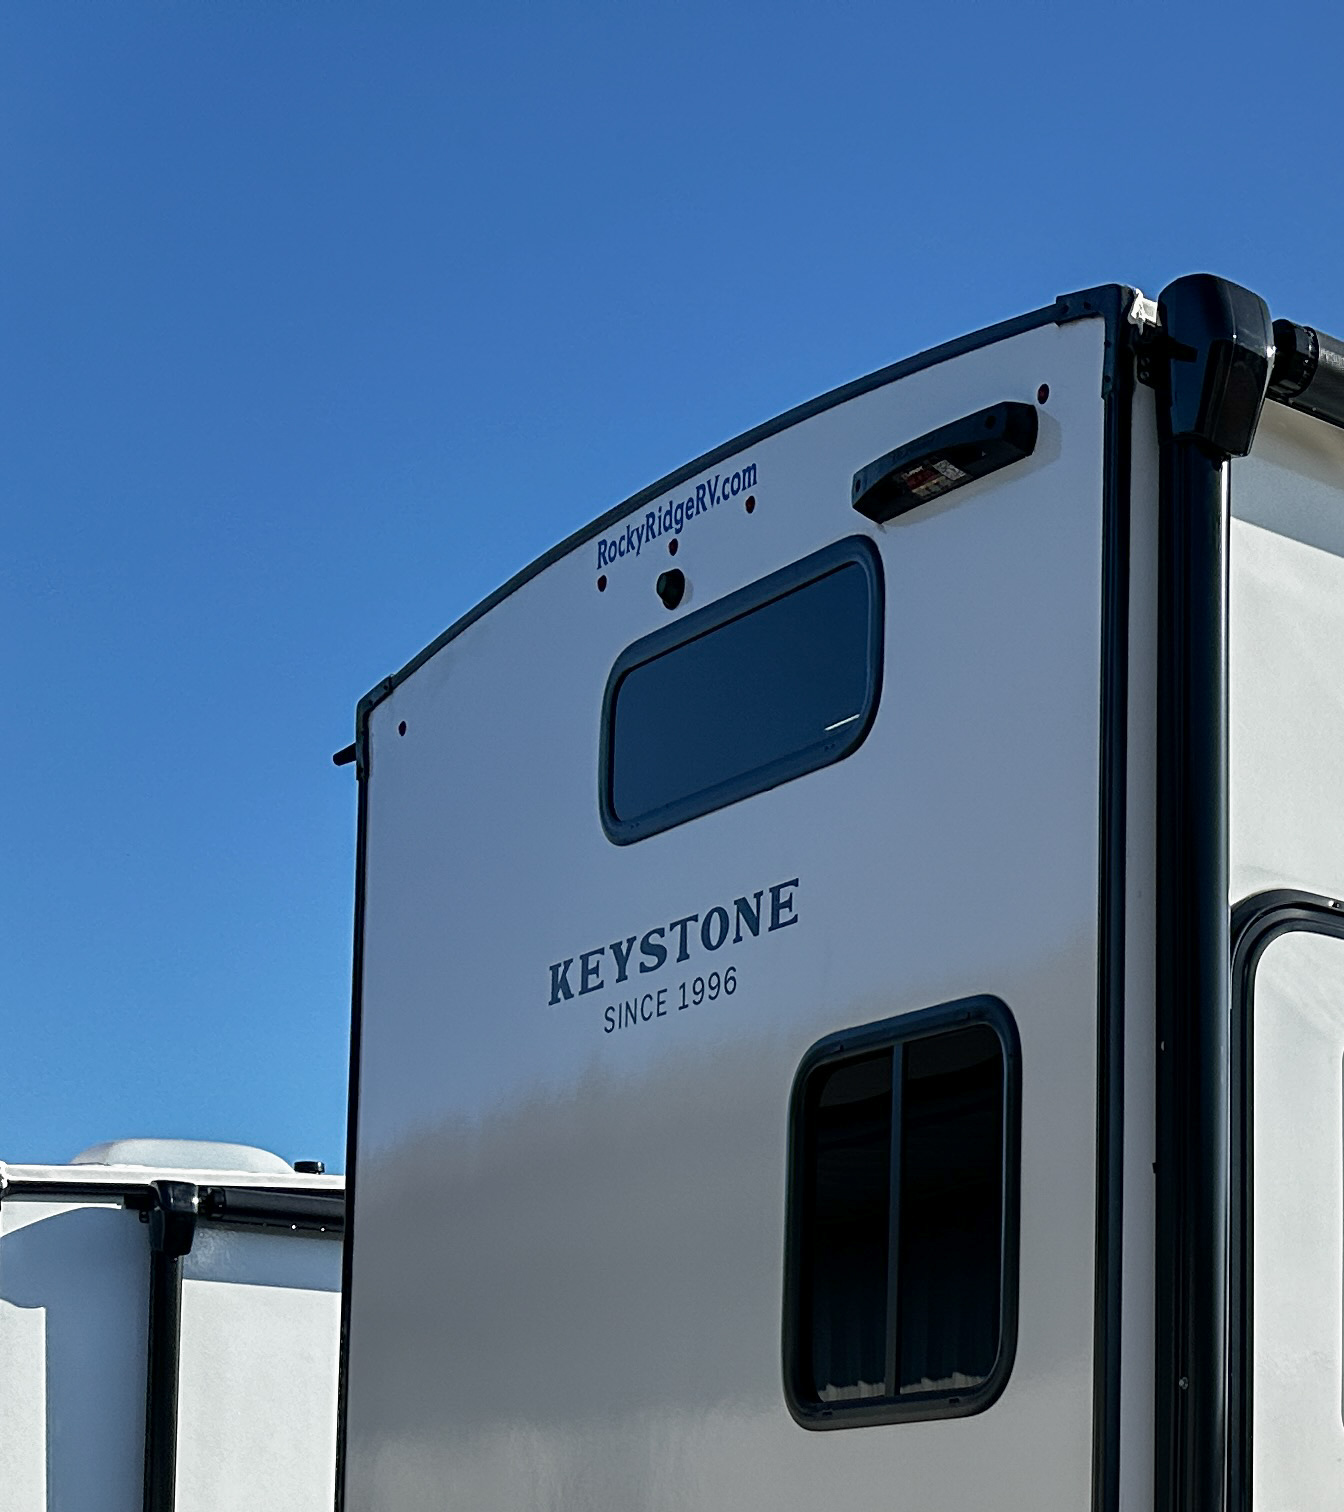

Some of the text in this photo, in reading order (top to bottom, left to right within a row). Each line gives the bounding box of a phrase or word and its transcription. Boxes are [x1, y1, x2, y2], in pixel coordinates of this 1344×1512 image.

[596, 463, 758, 570] RockyRidgeRV.com
[548, 877, 799, 1006] KEYSTONE
[603, 966, 738, 1034] SINCE 1996
